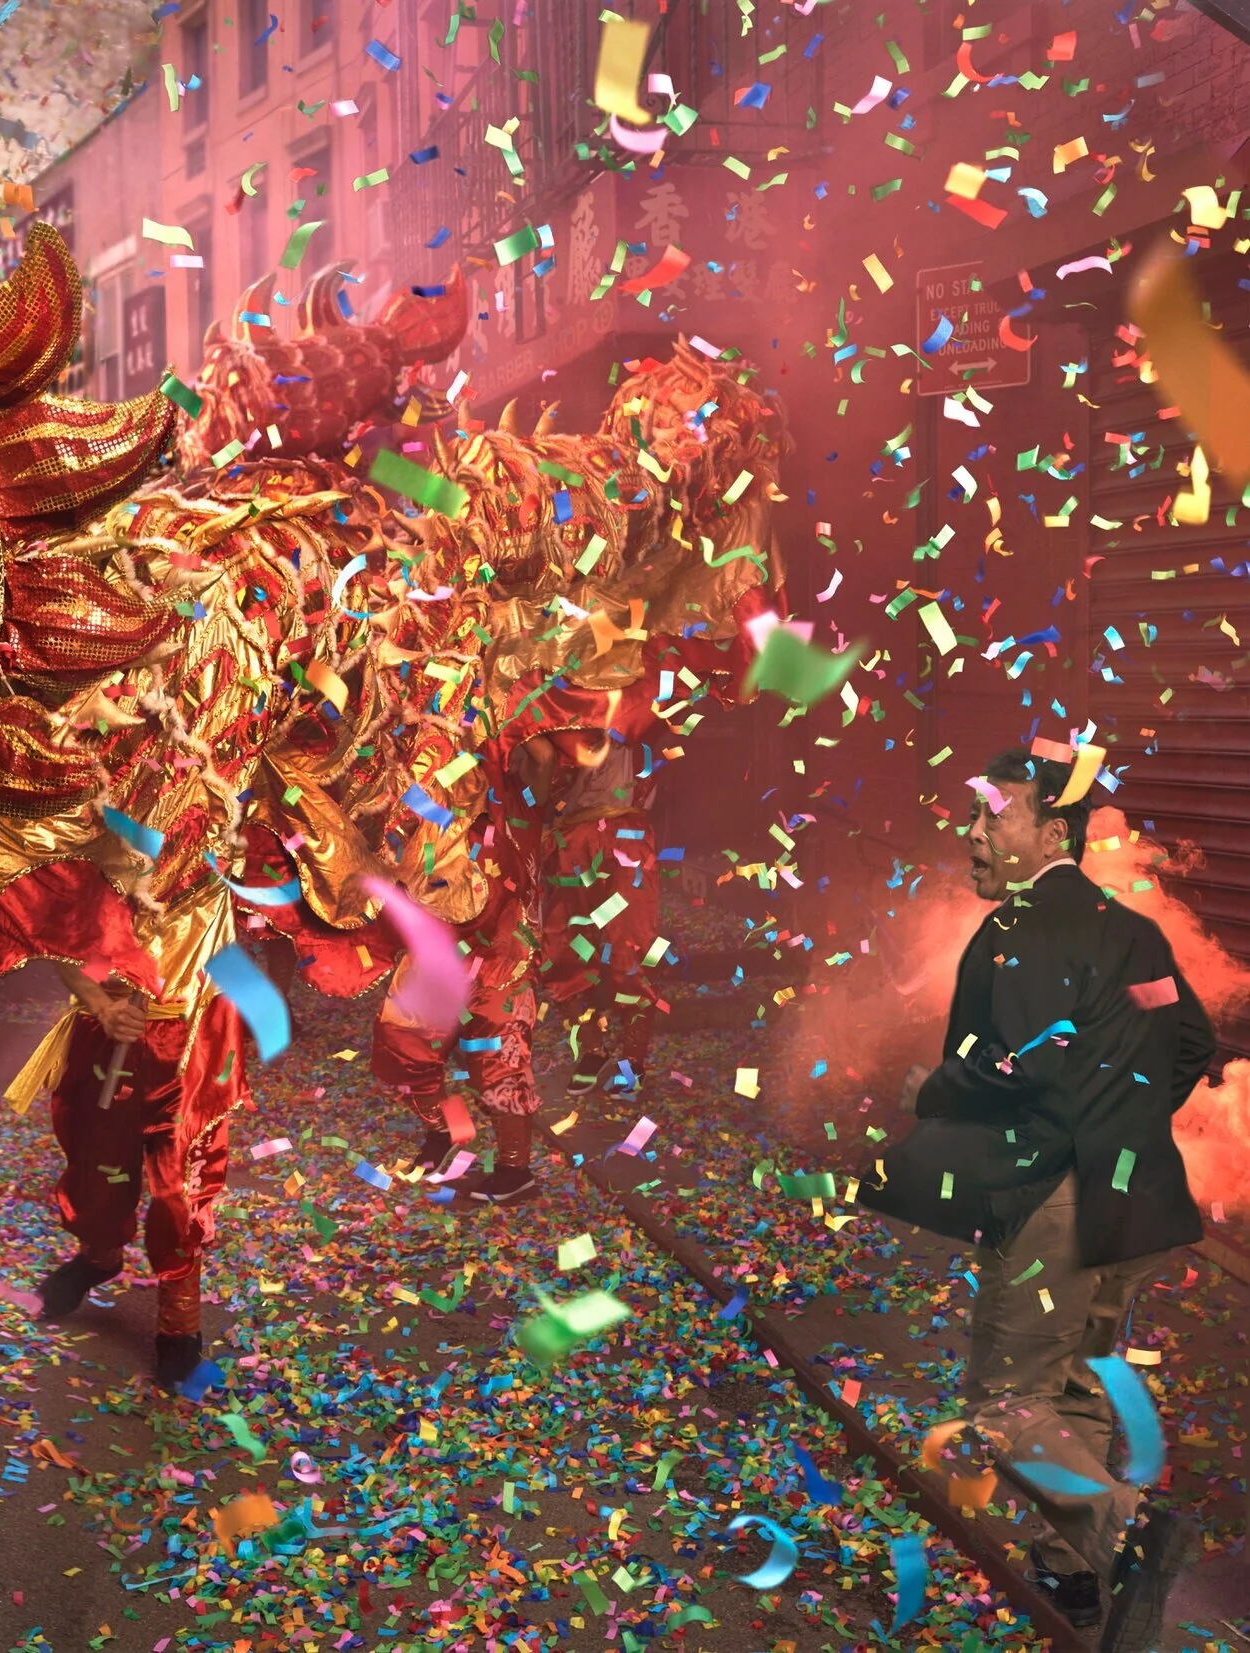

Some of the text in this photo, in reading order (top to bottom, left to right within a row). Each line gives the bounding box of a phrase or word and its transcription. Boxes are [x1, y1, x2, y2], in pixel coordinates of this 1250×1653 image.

[634, 182, 779, 250] 香港
[926, 282, 945, 301] NO
[477, 349, 534, 394] BARBER
[547, 320, 588, 355] HOP
